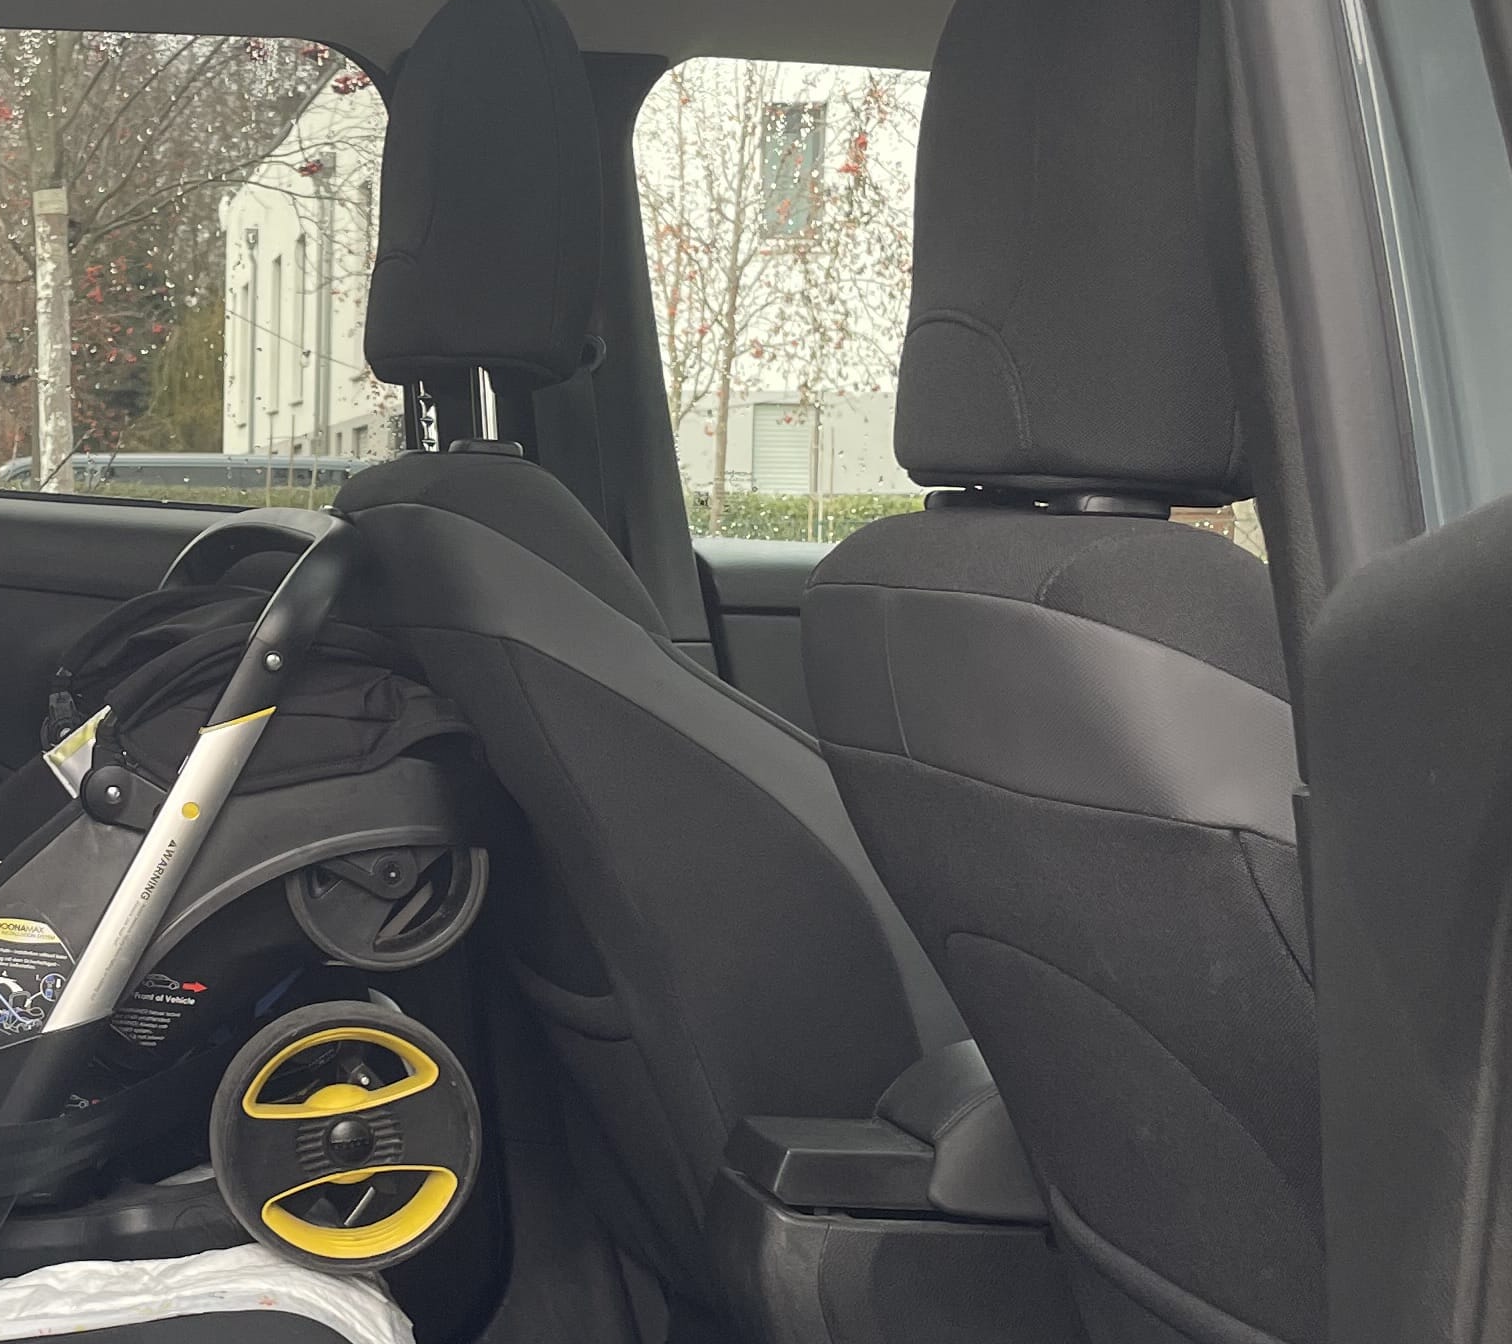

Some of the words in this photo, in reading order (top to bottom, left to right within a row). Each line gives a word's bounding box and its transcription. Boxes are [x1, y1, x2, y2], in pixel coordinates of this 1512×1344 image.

[140, 848, 176, 901] WARNING
[134, 991, 154, 1001] Front
[155, 994, 164, 1002] of
[165, 994, 196, 1005] Vehicle
